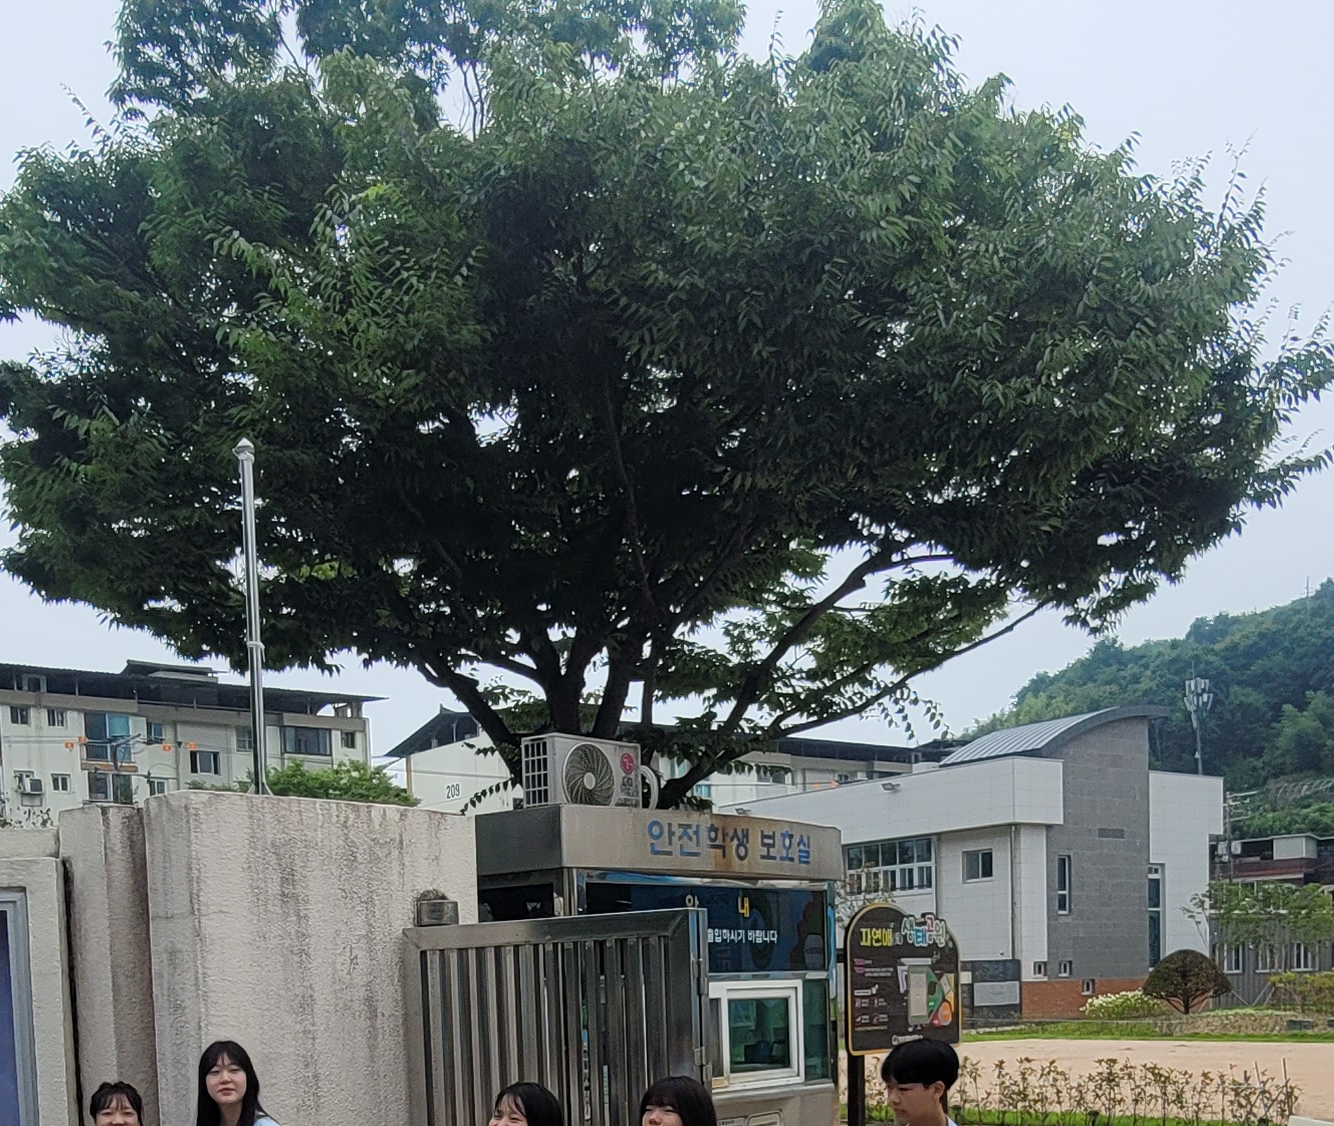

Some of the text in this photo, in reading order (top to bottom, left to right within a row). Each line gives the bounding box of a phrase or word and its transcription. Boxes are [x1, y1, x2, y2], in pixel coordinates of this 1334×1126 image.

[446, 783, 460, 799] 209
[647, 820, 811, 865] 안전학생 보호실
[738, 897, 750, 917] 내
[748, 930, 778, 944] 바랍니다
[900, 913, 946, 948] 생태공원
